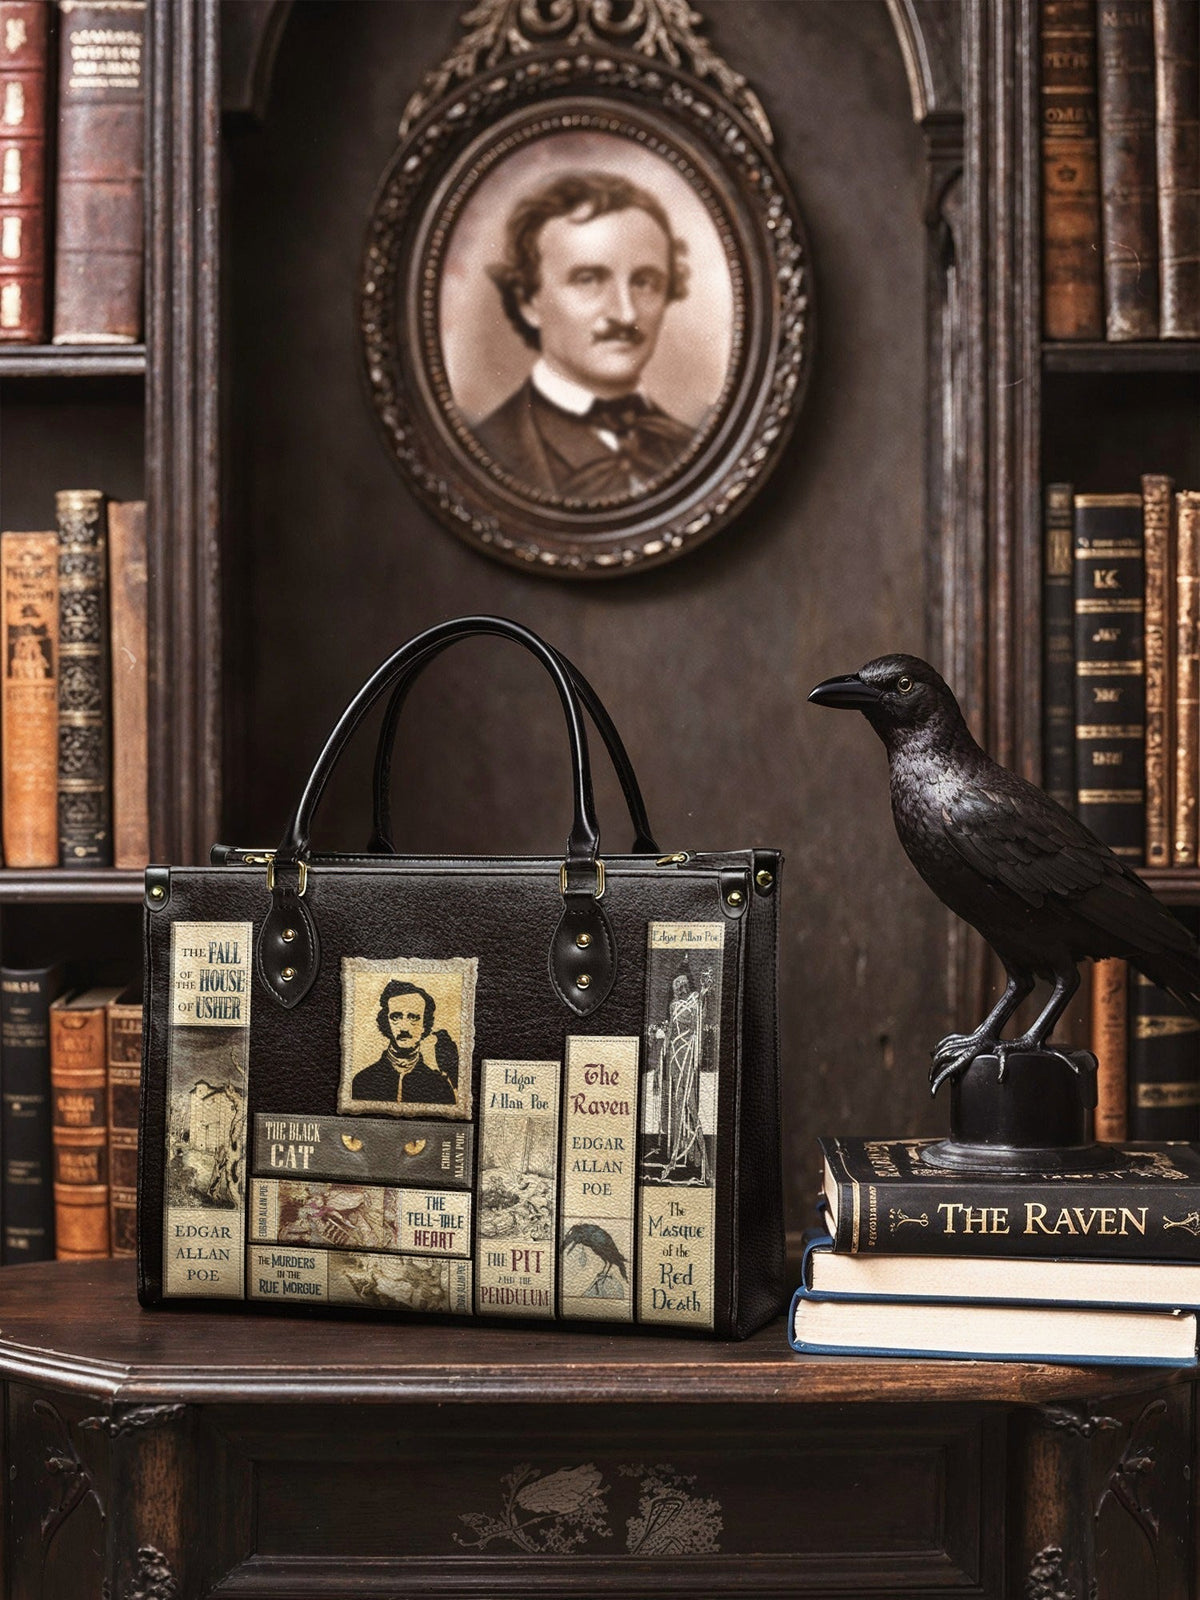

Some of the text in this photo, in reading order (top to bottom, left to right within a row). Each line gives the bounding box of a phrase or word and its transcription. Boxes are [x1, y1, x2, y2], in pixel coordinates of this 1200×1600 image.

[653, 930, 677, 944] Edgar
[181, 941, 241, 964] THE FALL
[175, 981, 196, 990] THE
[179, 969, 246, 992] OF HOUSE
[178, 996, 241, 1019] OF USHER
[504, 1069, 537, 1092] Edgar
[584, 1063, 619, 1086] The
[531, 1094, 549, 1110] Poe
[570, 1092, 630, 1115] Raven
[265, 1121, 321, 1143] THE BLACK
[572, 1137, 625, 1151] EDGAR
[270, 1143, 315, 1170] CAT
[571, 1160, 623, 1174] ALLAN
[582, 1182, 612, 1196] POE
[425, 1196, 446, 1211] THE
[668, 1201, 686, 1216] The
[407, 1212, 464, 1229] TELL-TALE
[648, 1215, 705, 1240] Masque
[937, 1202, 1149, 1236] THE RAVEN
[175, 1225, 232, 1239] EDGAR
[414, 1230, 455, 1249] HEART
[175, 1248, 230, 1261] ALLAN
[662, 1244, 690, 1258] of the
[258, 1253, 316, 1269] THE MURDERS
[486, 1249, 545, 1273] THE PIT
[187, 1269, 220, 1282] POE
[277, 1271, 301, 1280] IN THE
[660, 1263, 693, 1290] Red
[259, 1279, 322, 1296] RUE MORGUE
[480, 1286, 549, 1307] PENDULUM
[652, 1288, 701, 1312] Death
